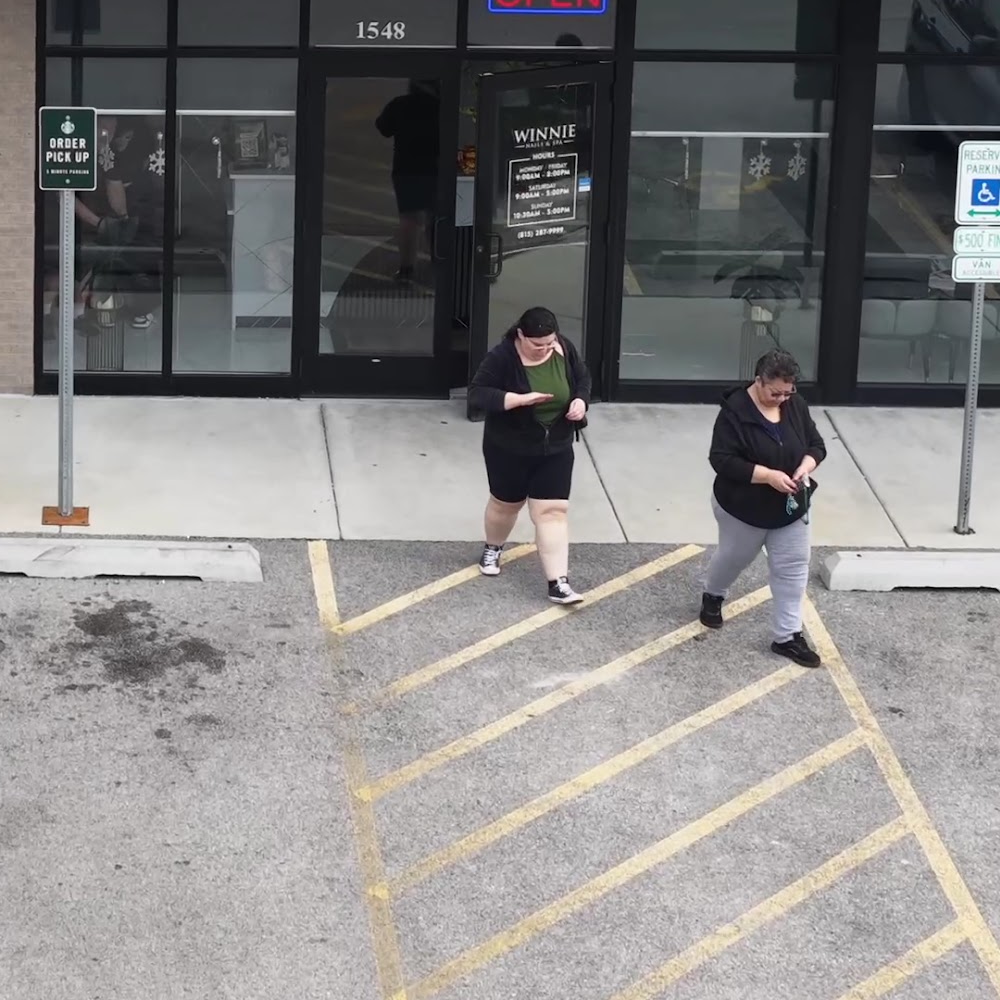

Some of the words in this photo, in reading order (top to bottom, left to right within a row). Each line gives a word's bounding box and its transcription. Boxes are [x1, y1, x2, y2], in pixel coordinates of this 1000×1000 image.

[356, 21, 406, 40] 1548
[514, 124, 577, 143] WINNIE
[50, 137, 86, 149] ORDER
[46, 151, 72, 163] PICK
[75, 151, 90, 163] UP
[532, 152, 556, 160] HOURS
[958, 233, 984, 248] $500
